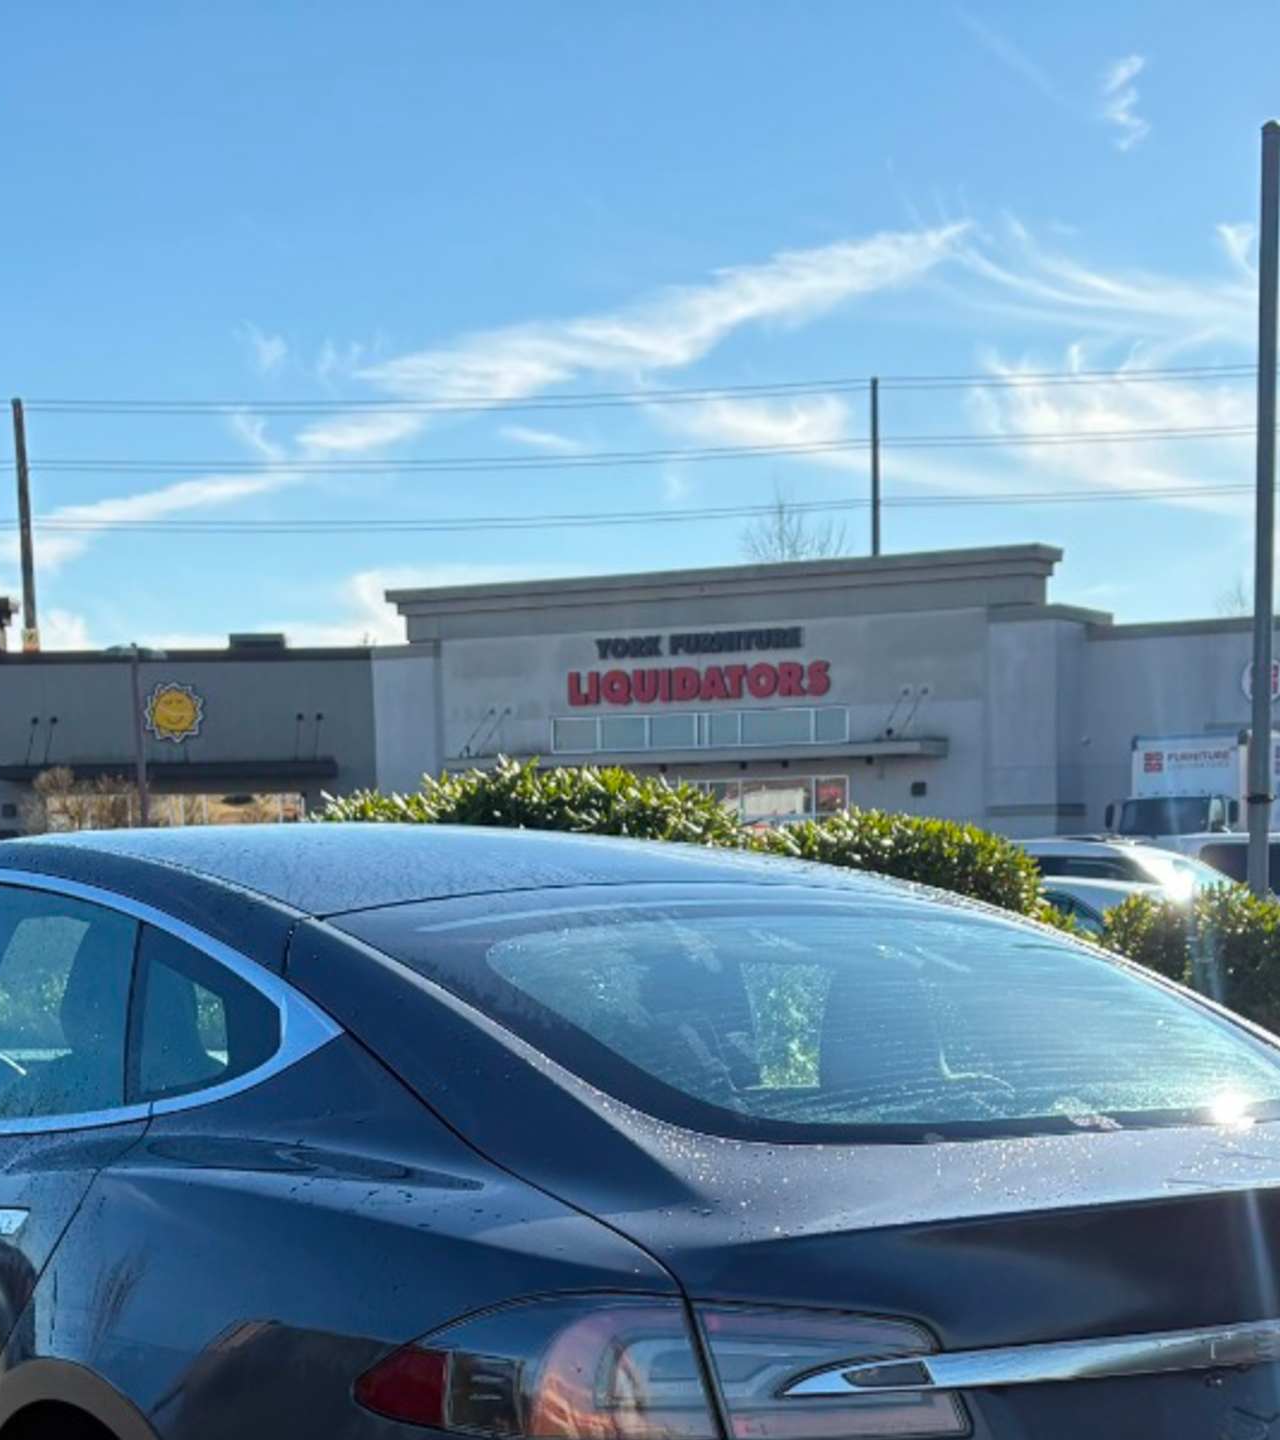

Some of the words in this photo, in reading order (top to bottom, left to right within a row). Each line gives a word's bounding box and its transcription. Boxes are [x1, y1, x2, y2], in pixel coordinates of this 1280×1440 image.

[594, 635, 663, 659] YORK
[670, 626, 803, 655] FURNITURE
[567, 660, 831, 706] LIQUIDATORS
